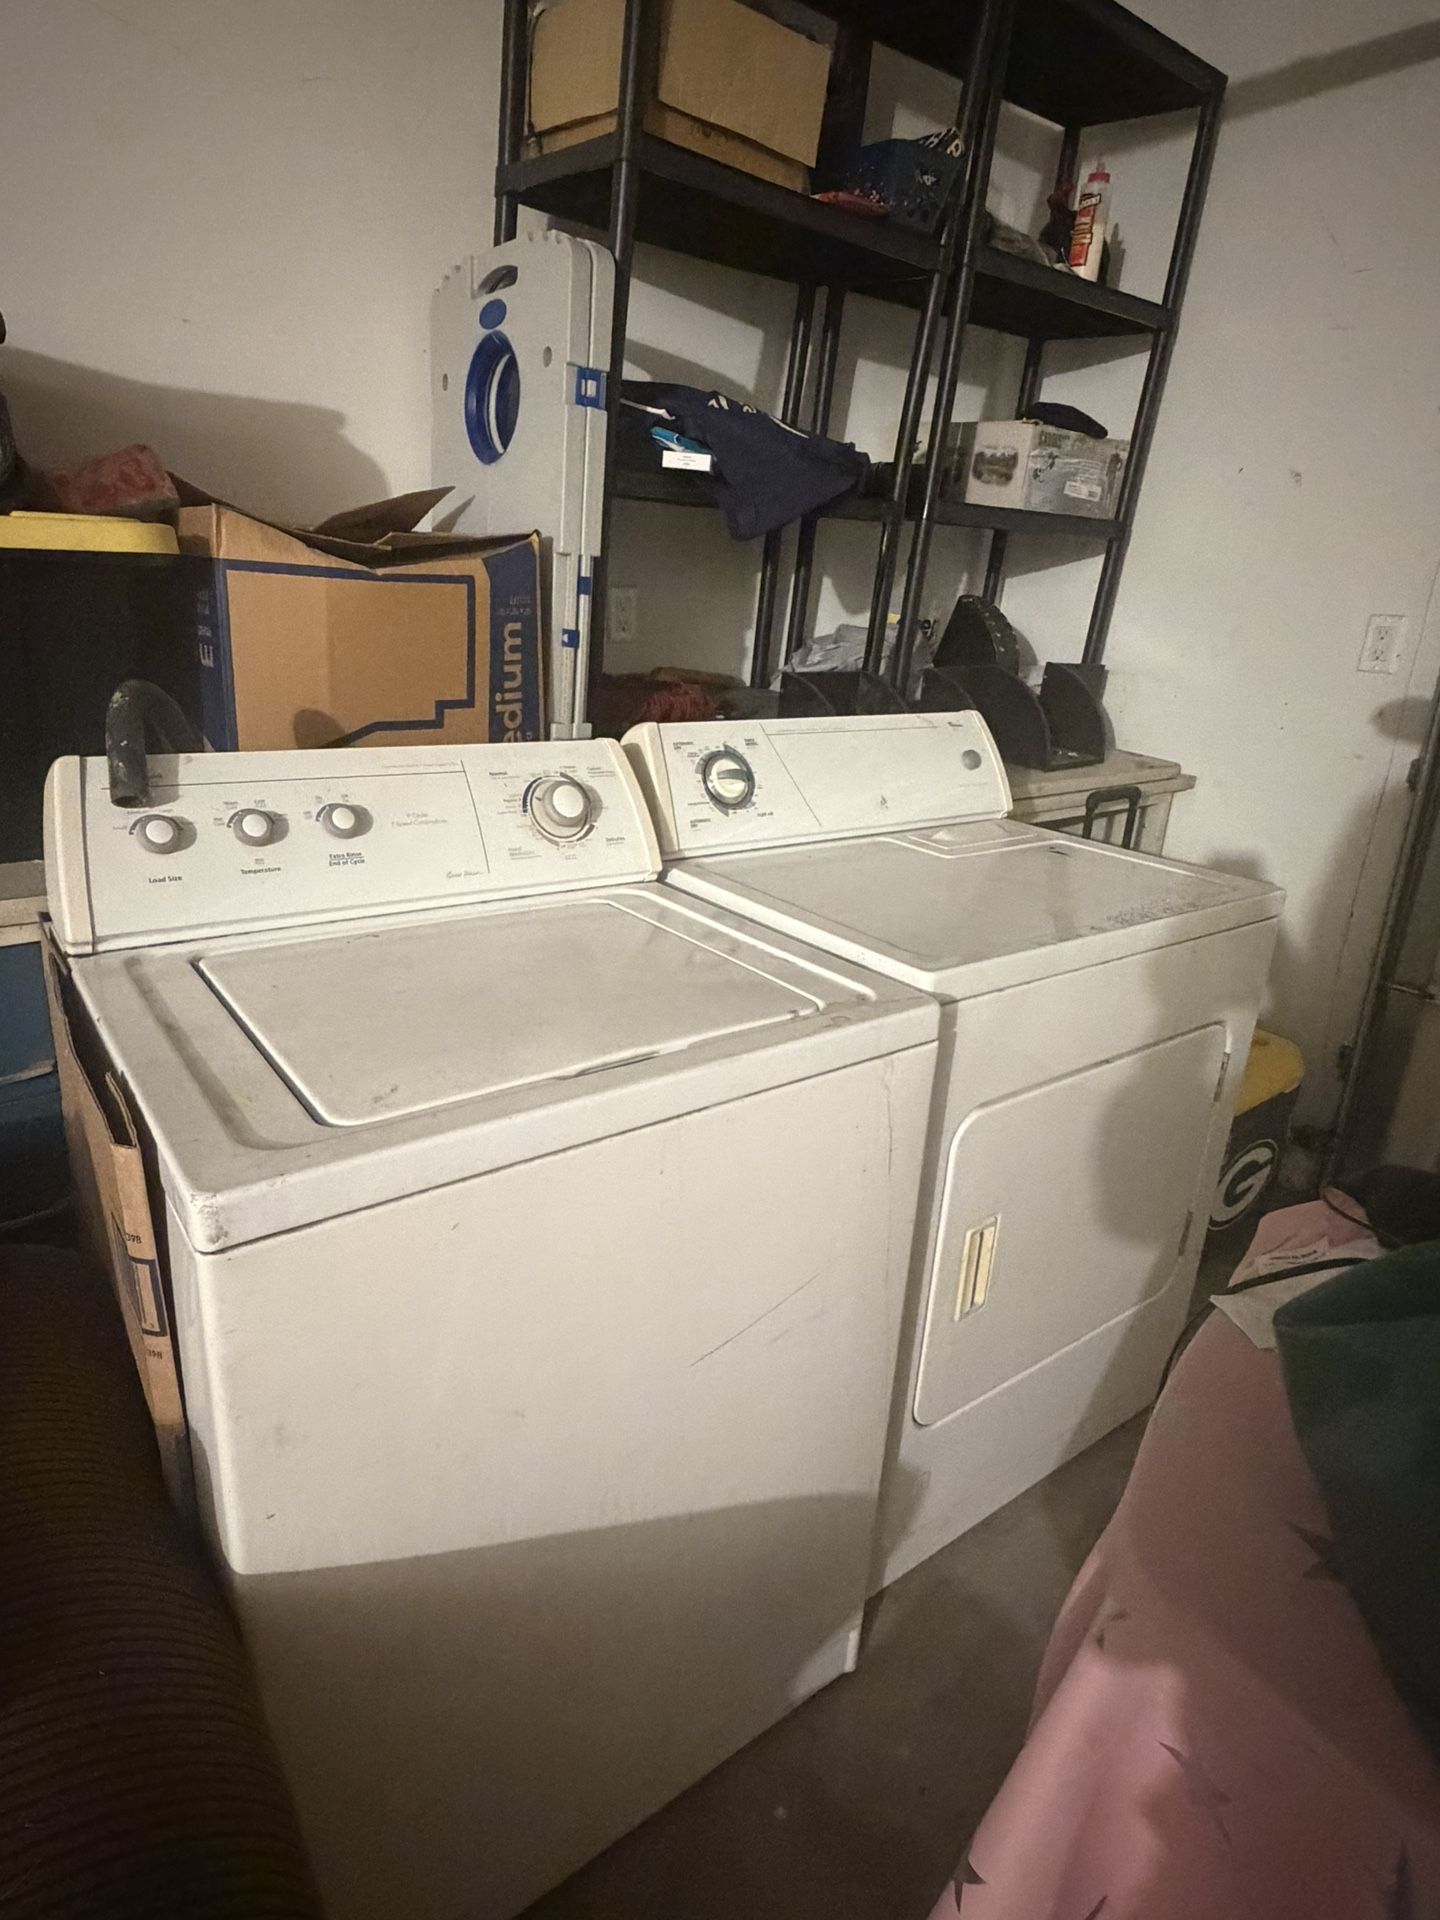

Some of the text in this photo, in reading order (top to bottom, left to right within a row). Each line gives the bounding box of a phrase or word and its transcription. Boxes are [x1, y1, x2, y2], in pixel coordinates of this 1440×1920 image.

[495, 622, 522, 743] edium
[240, 865, 281, 875] Temperature
[148, 873, 183, 884] Load Size
